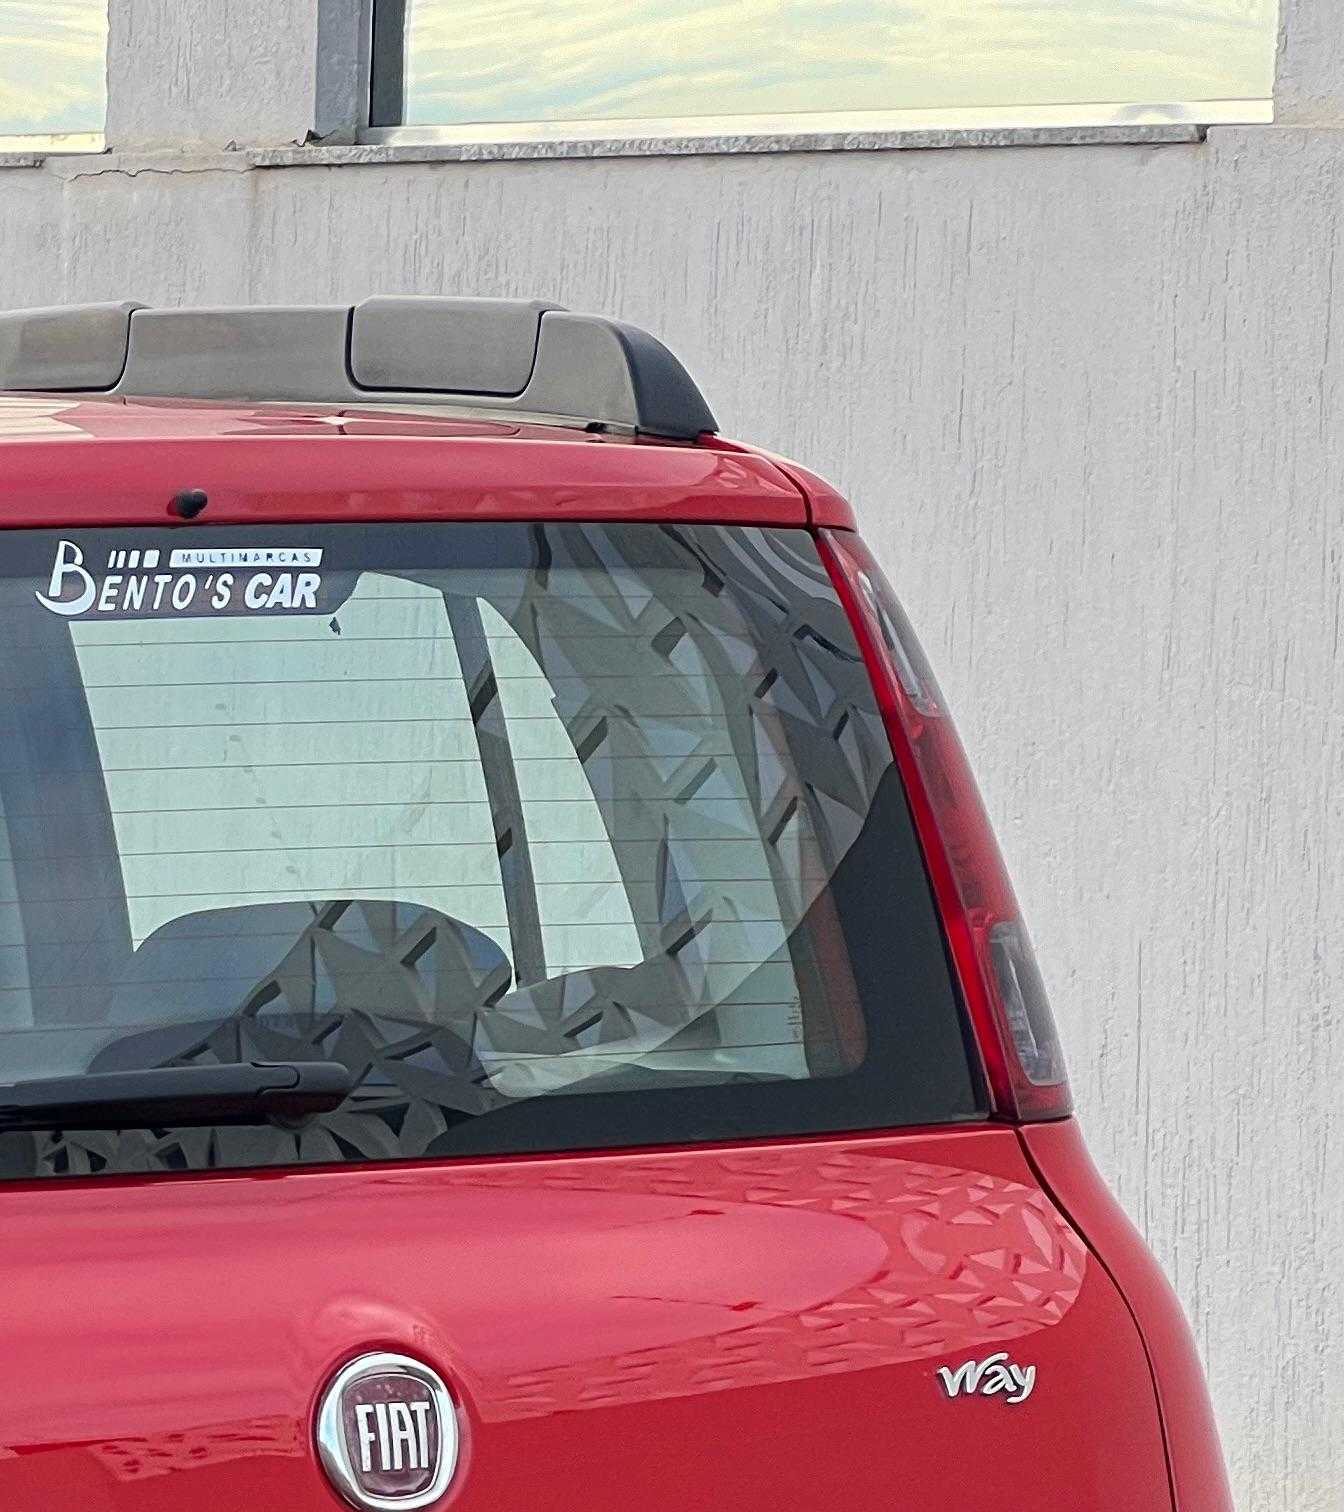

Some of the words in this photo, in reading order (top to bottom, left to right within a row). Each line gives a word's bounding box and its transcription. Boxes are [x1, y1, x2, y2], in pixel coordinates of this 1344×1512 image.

[35, 540, 234, 616] BENTO'S
[244, 573, 321, 609] CAR
[181, 552, 312, 564] MULTIMARCAS
[355, 1401, 430, 1472] FIAT
